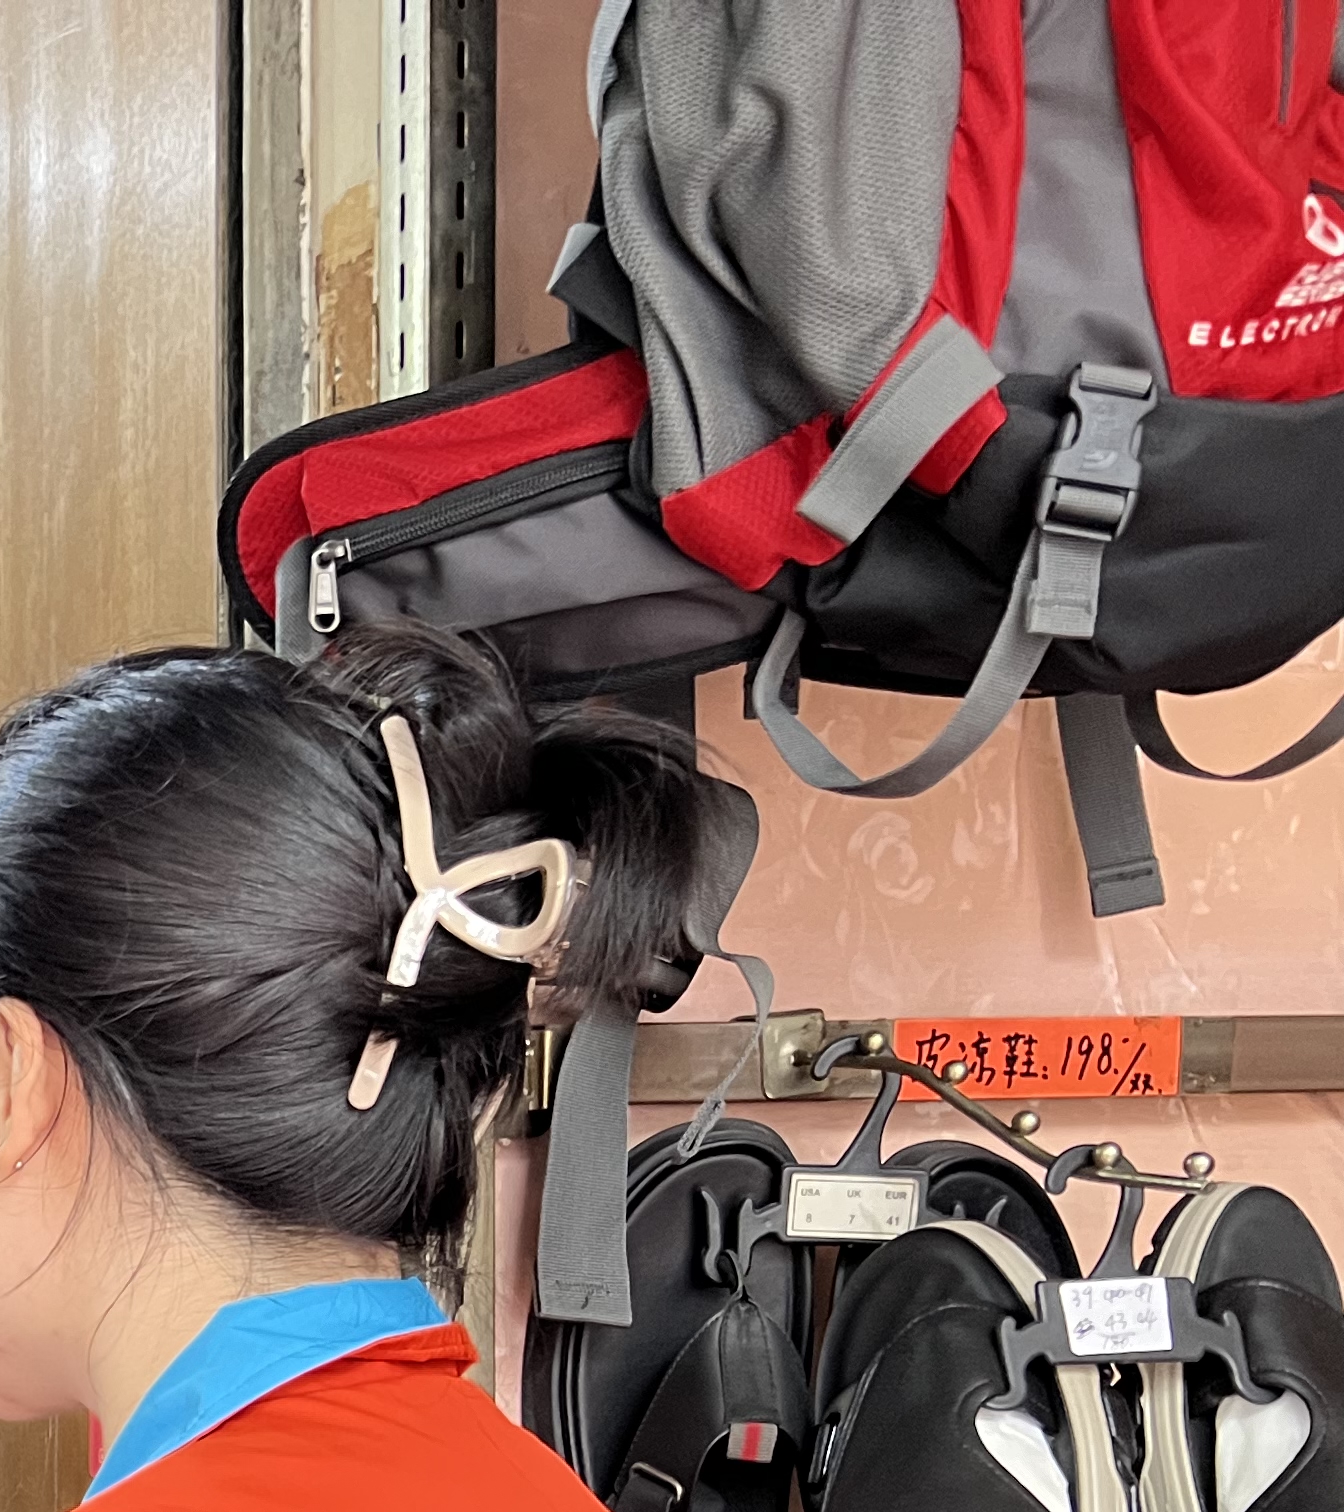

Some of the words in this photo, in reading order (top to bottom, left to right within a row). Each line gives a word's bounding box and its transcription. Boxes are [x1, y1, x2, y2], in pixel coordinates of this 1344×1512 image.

[800, 1188, 821, 1197] USA
[847, 1189, 862, 1198] UK
[885, 1191, 907, 1200] EUR
[805, 1212, 812, 1224] 8
[849, 1214, 856, 1225] 7
[886, 1215, 900, 1227] 41
